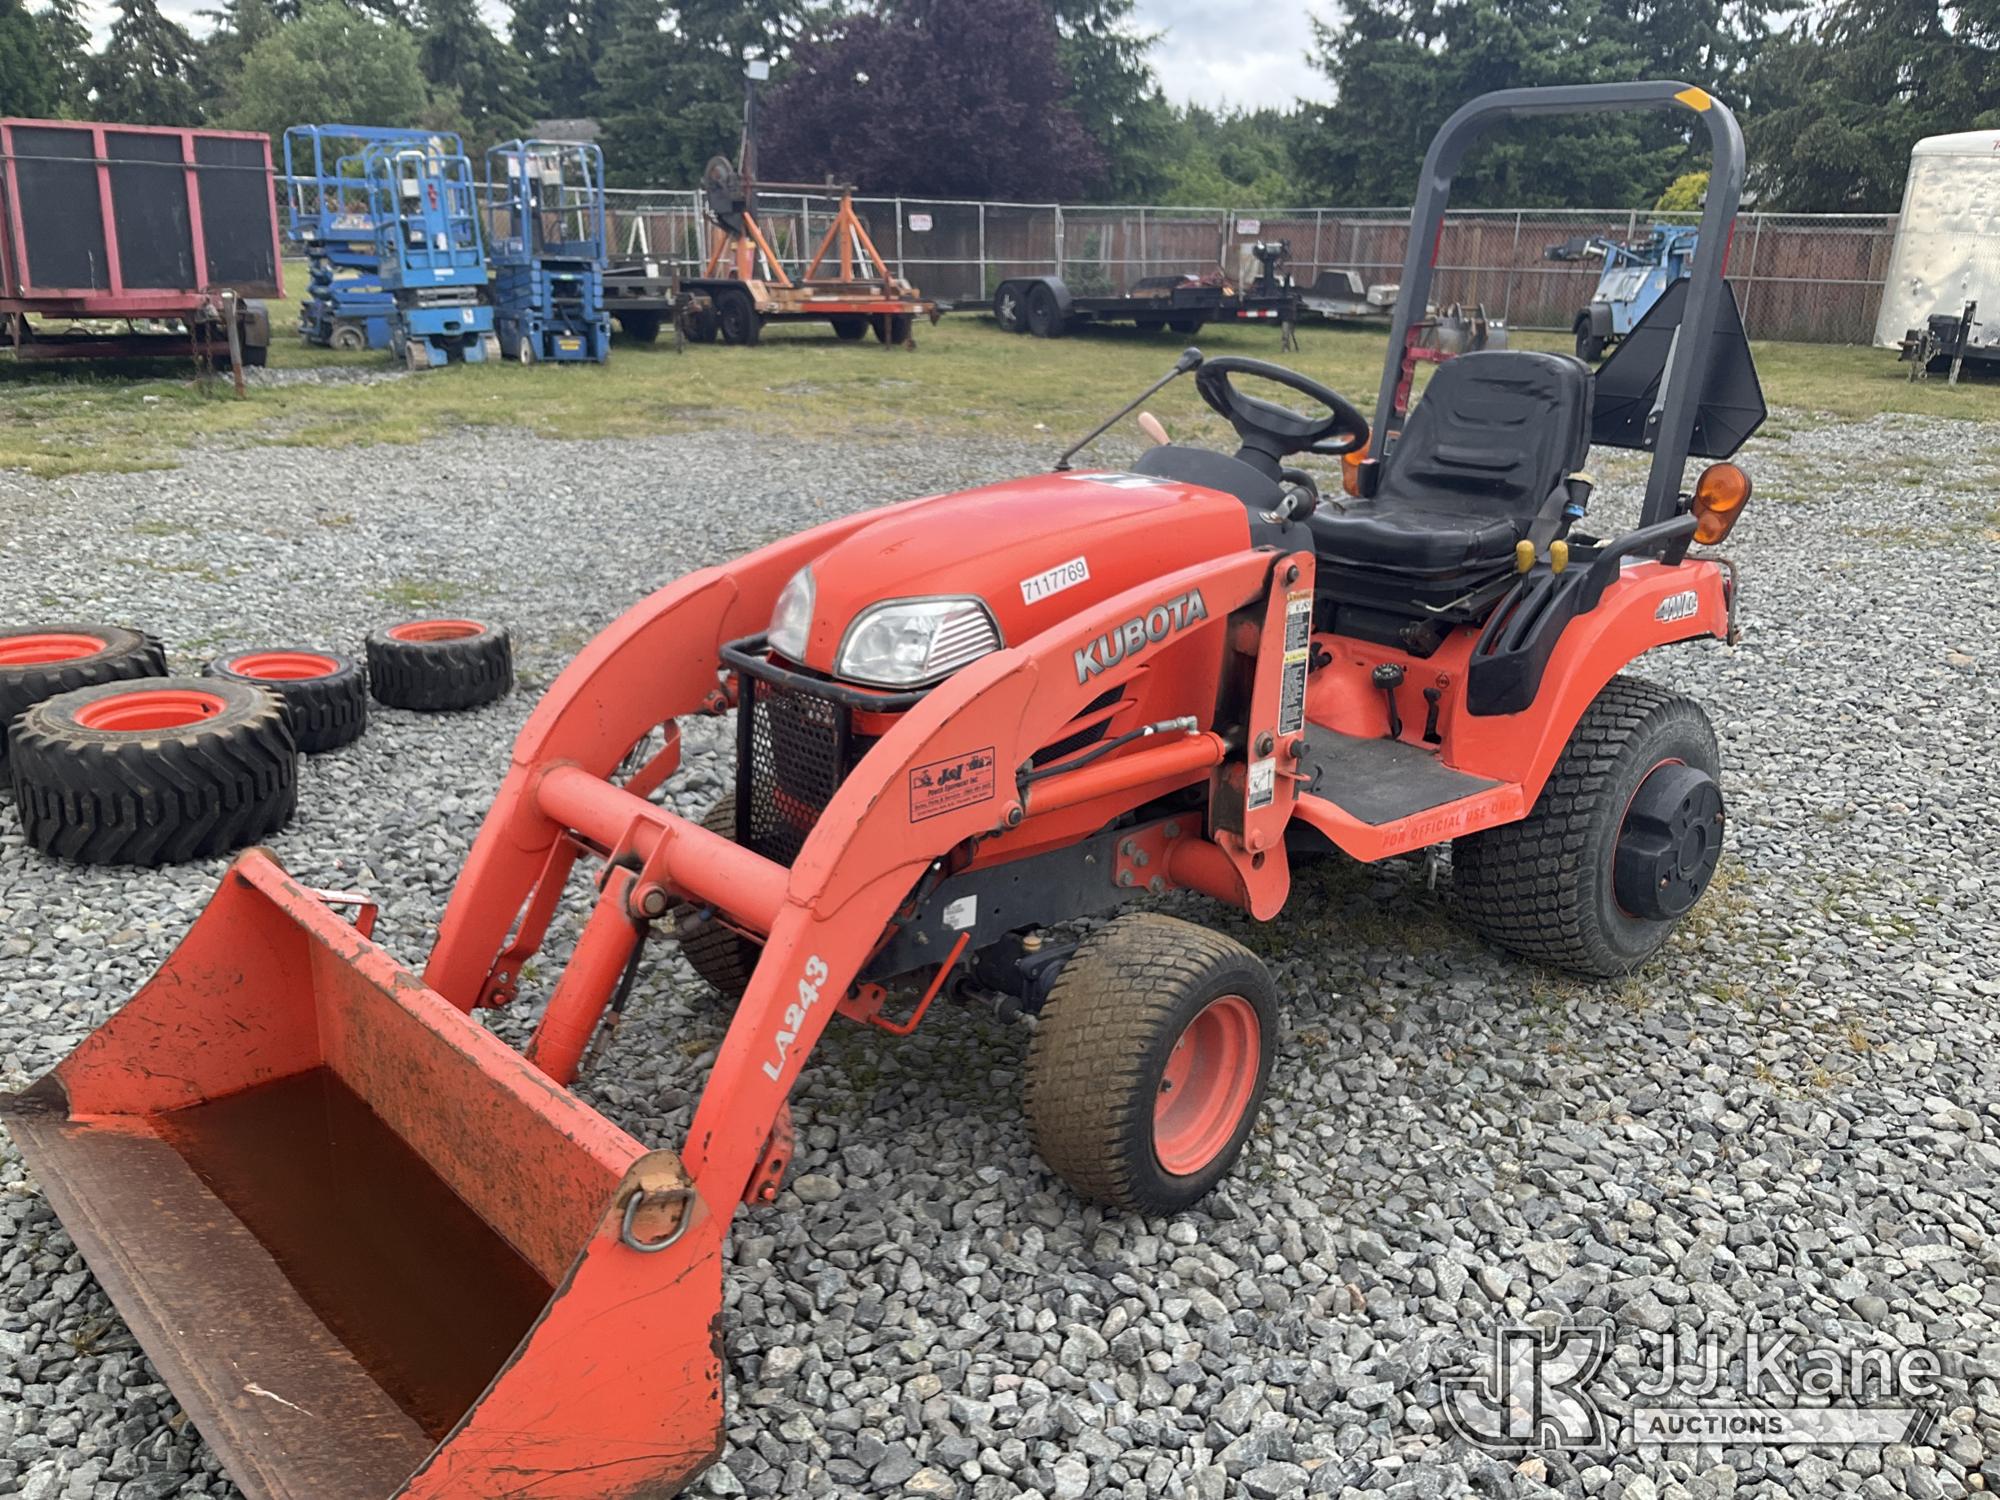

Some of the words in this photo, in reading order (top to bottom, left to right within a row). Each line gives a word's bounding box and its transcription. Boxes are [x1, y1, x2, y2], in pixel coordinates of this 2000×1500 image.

[1023, 561, 1086, 601] 7117769
[1655, 591, 1697, 622] 4WD
[1073, 588, 1208, 685] KUBOTA
[1382, 832, 1406, 848] FOR
[1411, 813, 1460, 839] OFFICIAL
[1466, 805, 1486, 822] USE
[762, 955, 828, 1082] LA243
